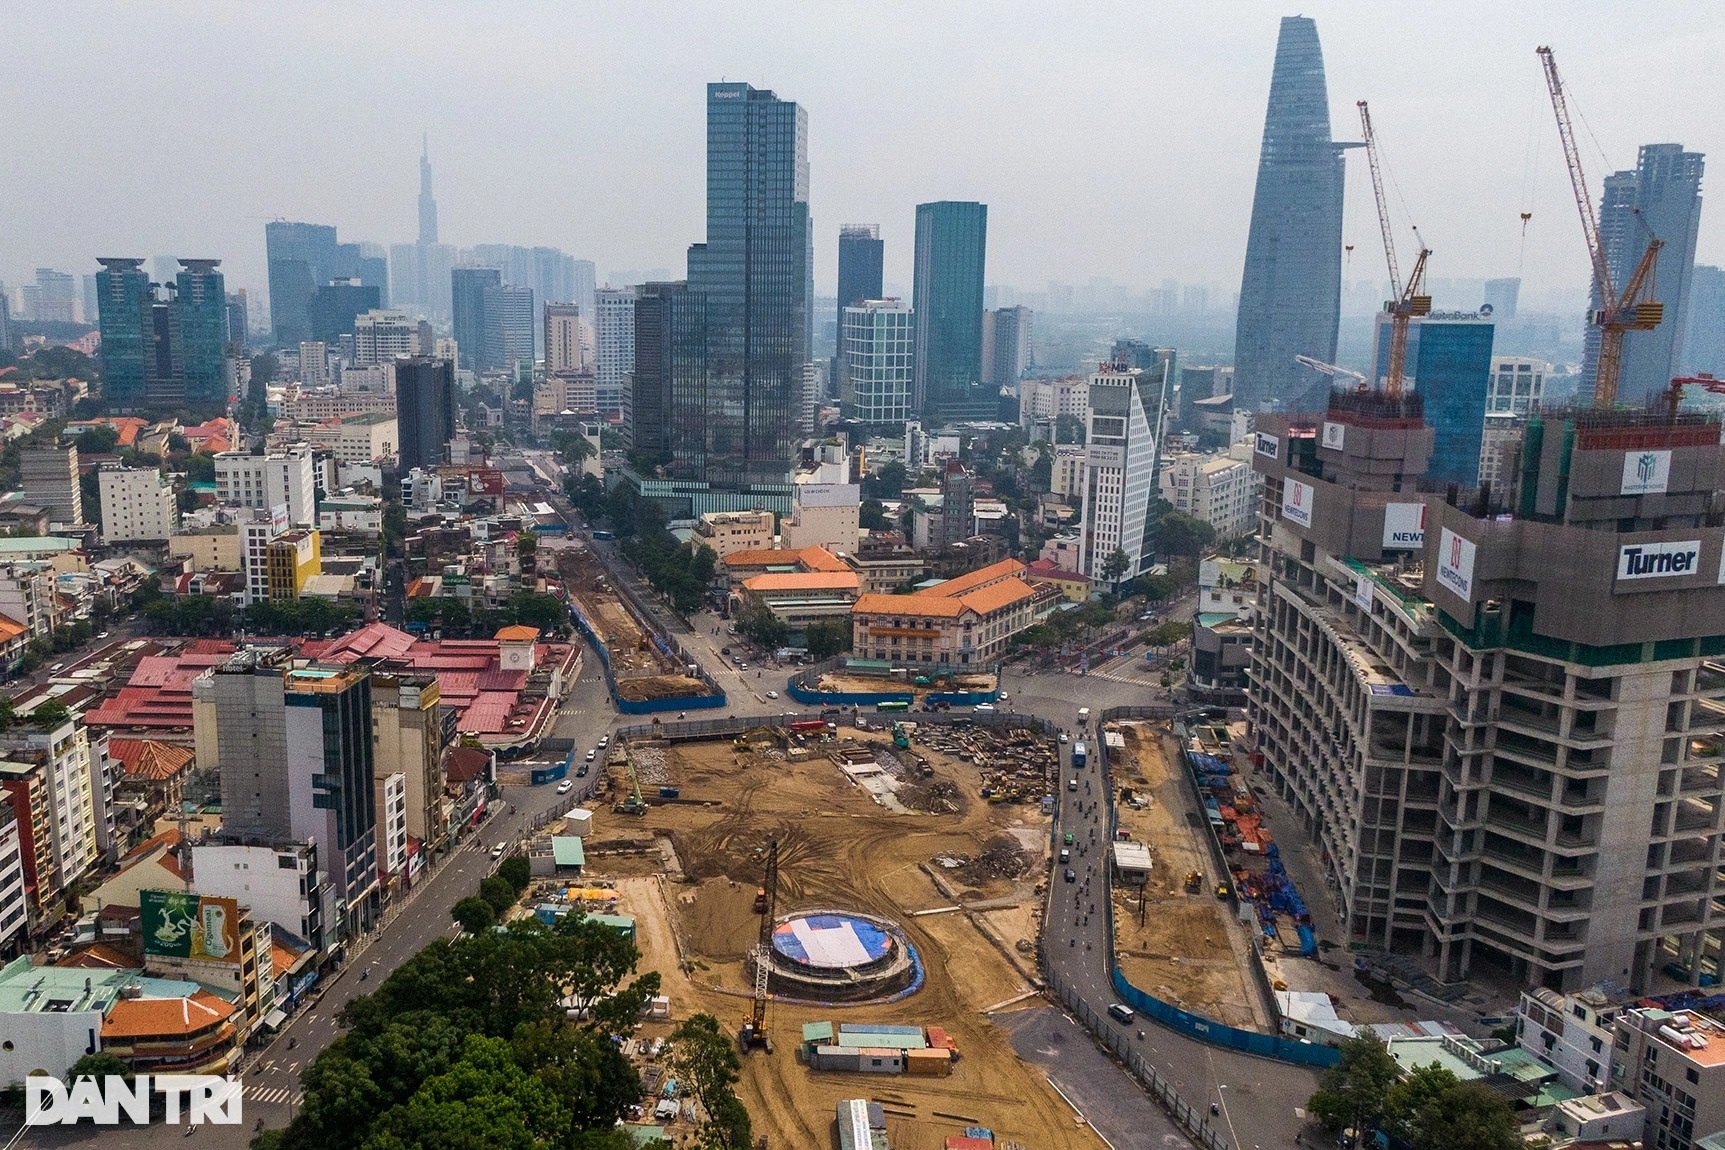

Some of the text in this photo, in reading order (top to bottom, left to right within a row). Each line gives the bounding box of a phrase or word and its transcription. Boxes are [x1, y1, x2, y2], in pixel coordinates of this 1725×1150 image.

[1111, 363, 1128, 373] MB
[1257, 433, 1277, 456] Turner
[1285, 504, 1309, 522] NEWTECONS
[1624, 547, 1696, 576] Turner
[1440, 565, 1468, 592] NEWTECONS
